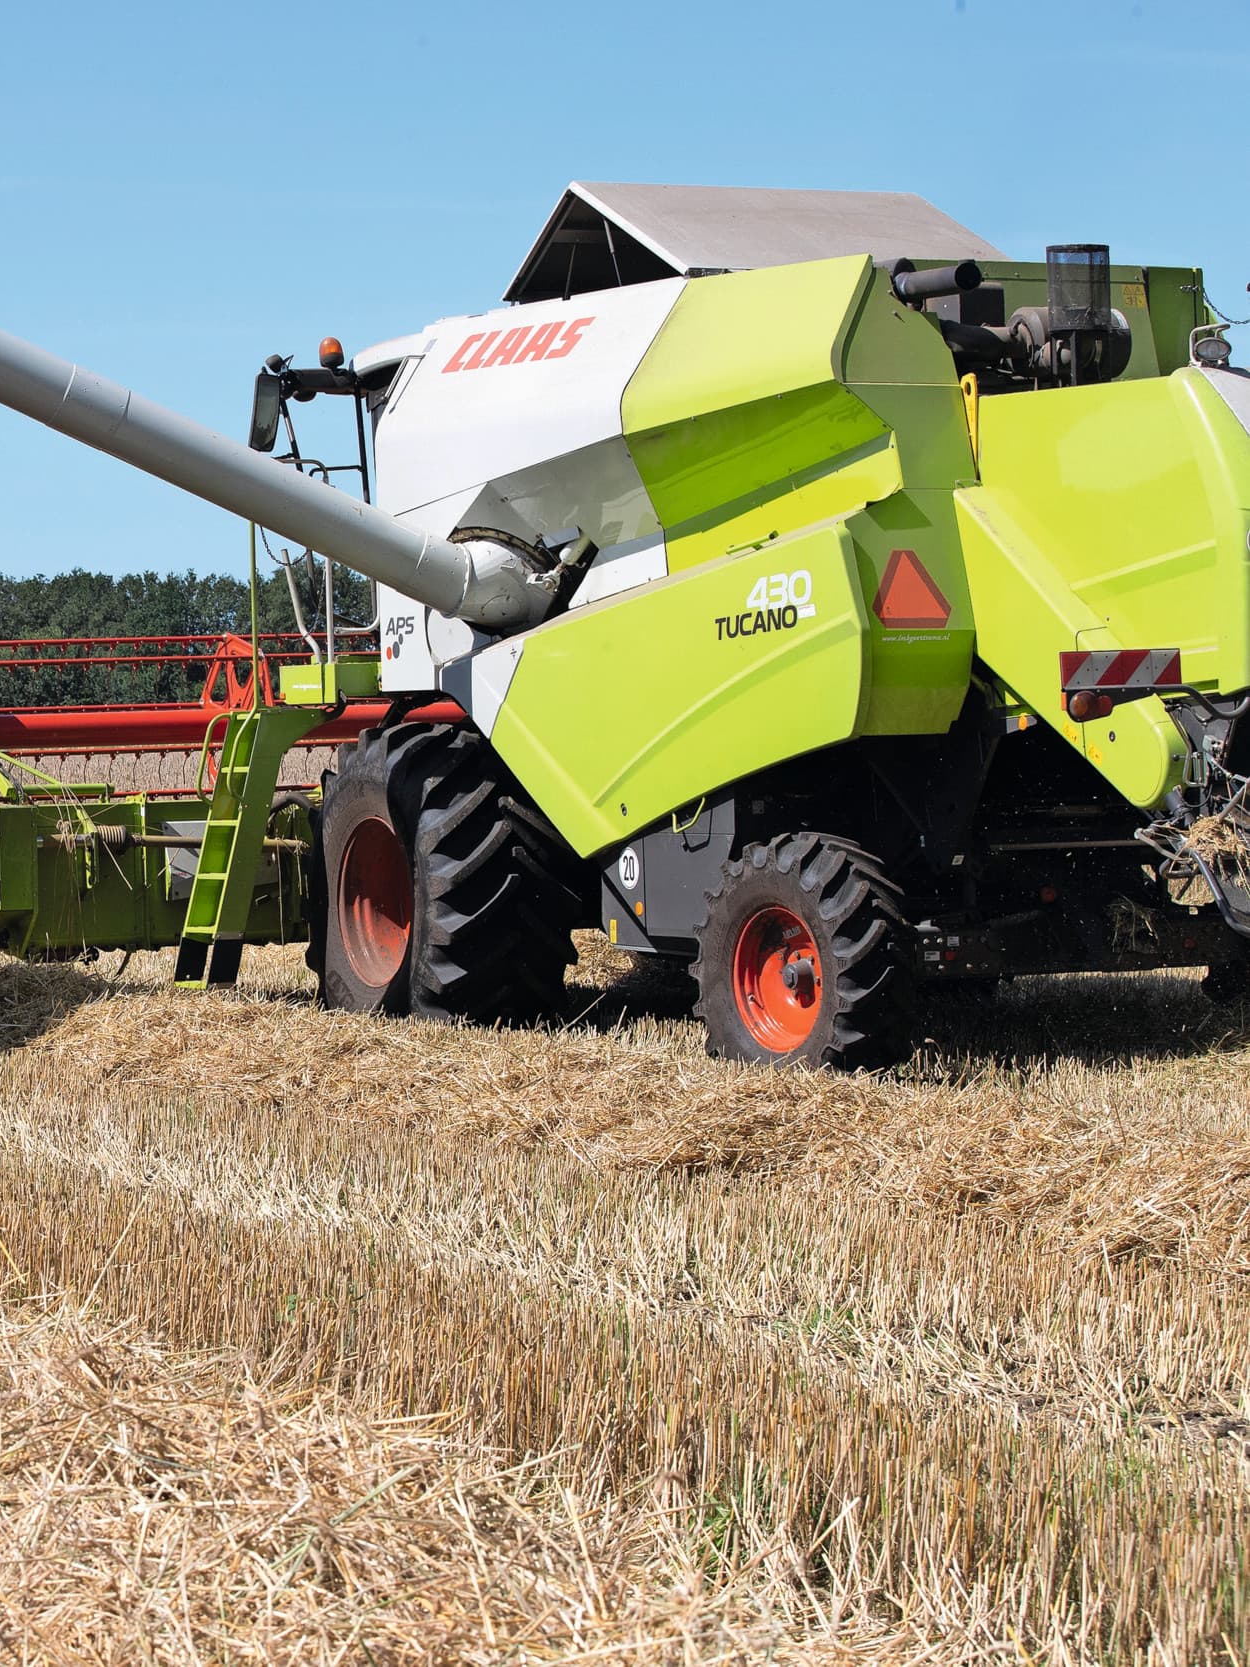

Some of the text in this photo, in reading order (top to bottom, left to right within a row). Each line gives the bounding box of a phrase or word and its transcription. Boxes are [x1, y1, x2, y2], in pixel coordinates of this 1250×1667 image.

[441, 316, 597, 374] CLAAS
[746, 569, 812, 612] 430
[385, 616, 415, 635] APS
[715, 605, 798, 641] TUCANO
[622, 855, 635, 881] 20
